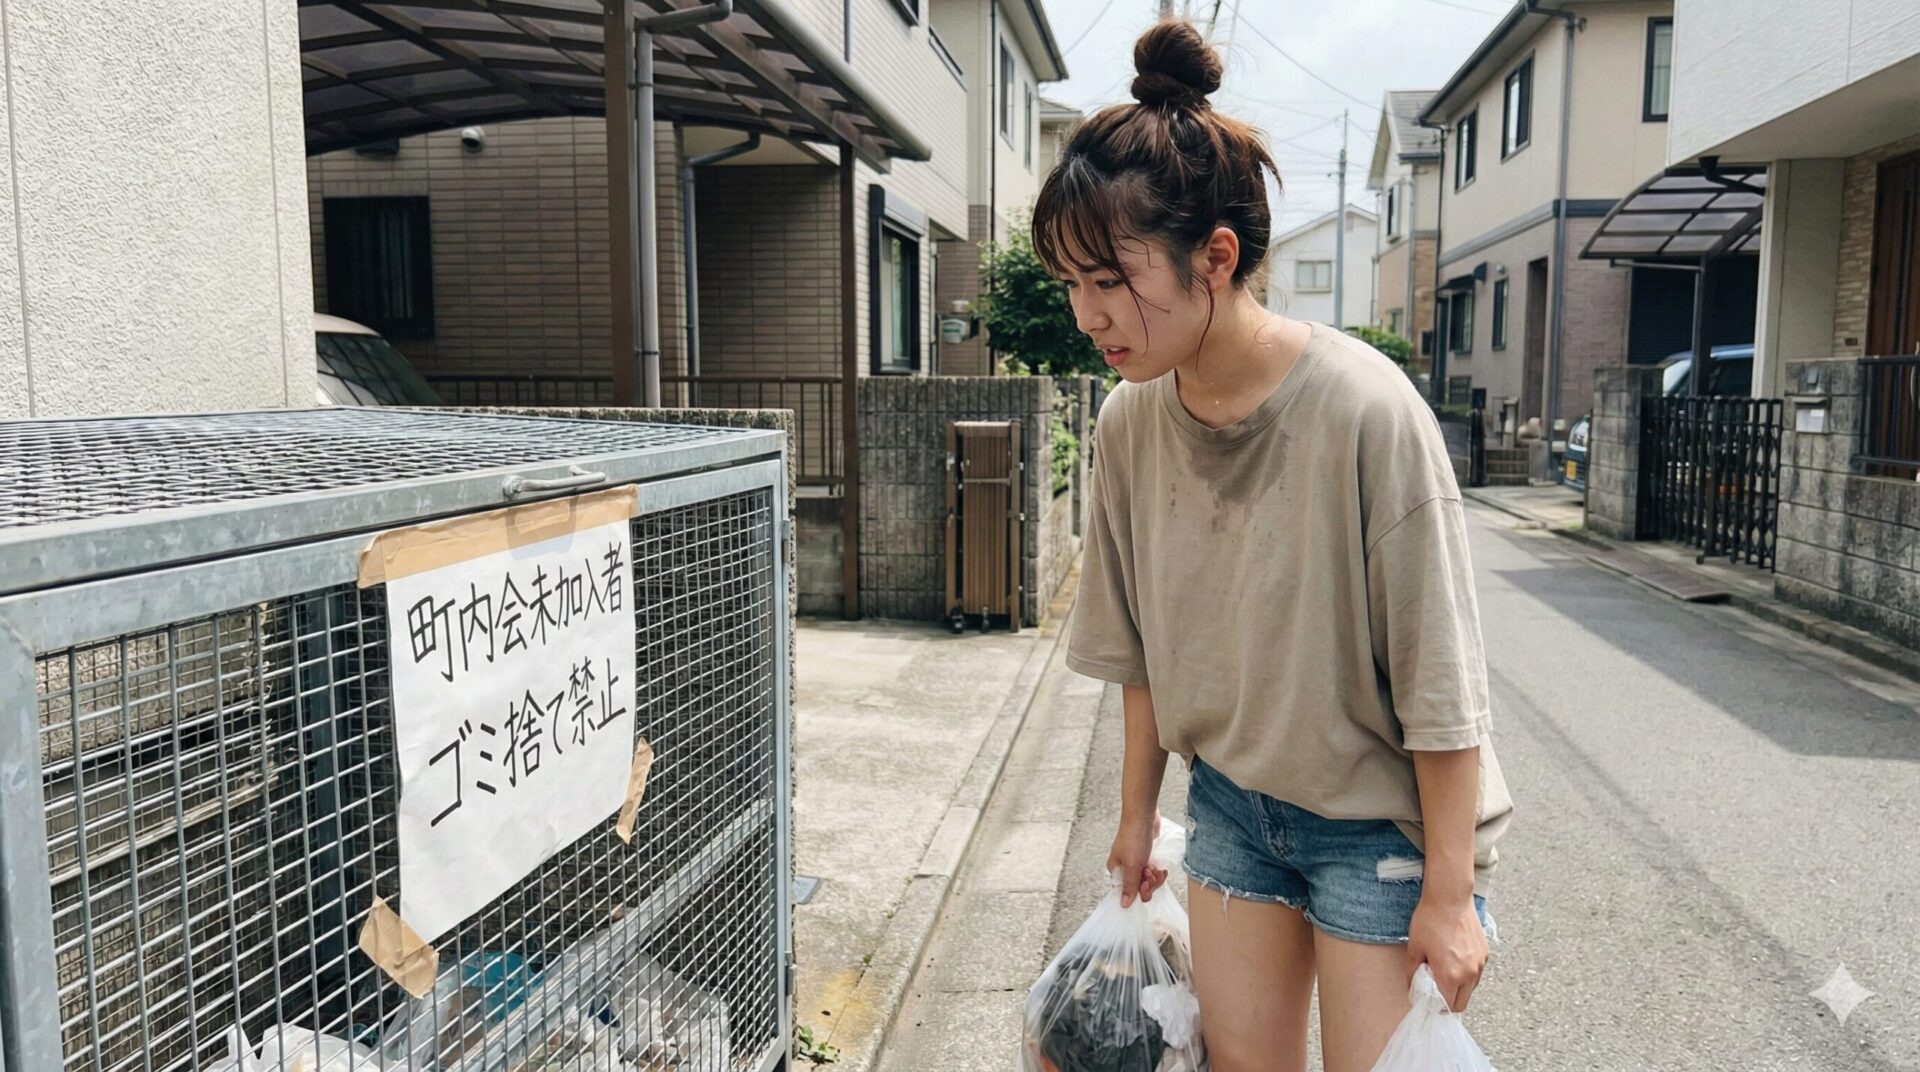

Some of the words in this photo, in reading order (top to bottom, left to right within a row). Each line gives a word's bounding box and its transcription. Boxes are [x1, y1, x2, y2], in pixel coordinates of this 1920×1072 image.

[407, 542, 623, 682] 町内会未加入者
[429, 657, 626, 826] ゴミ捨て禁止
